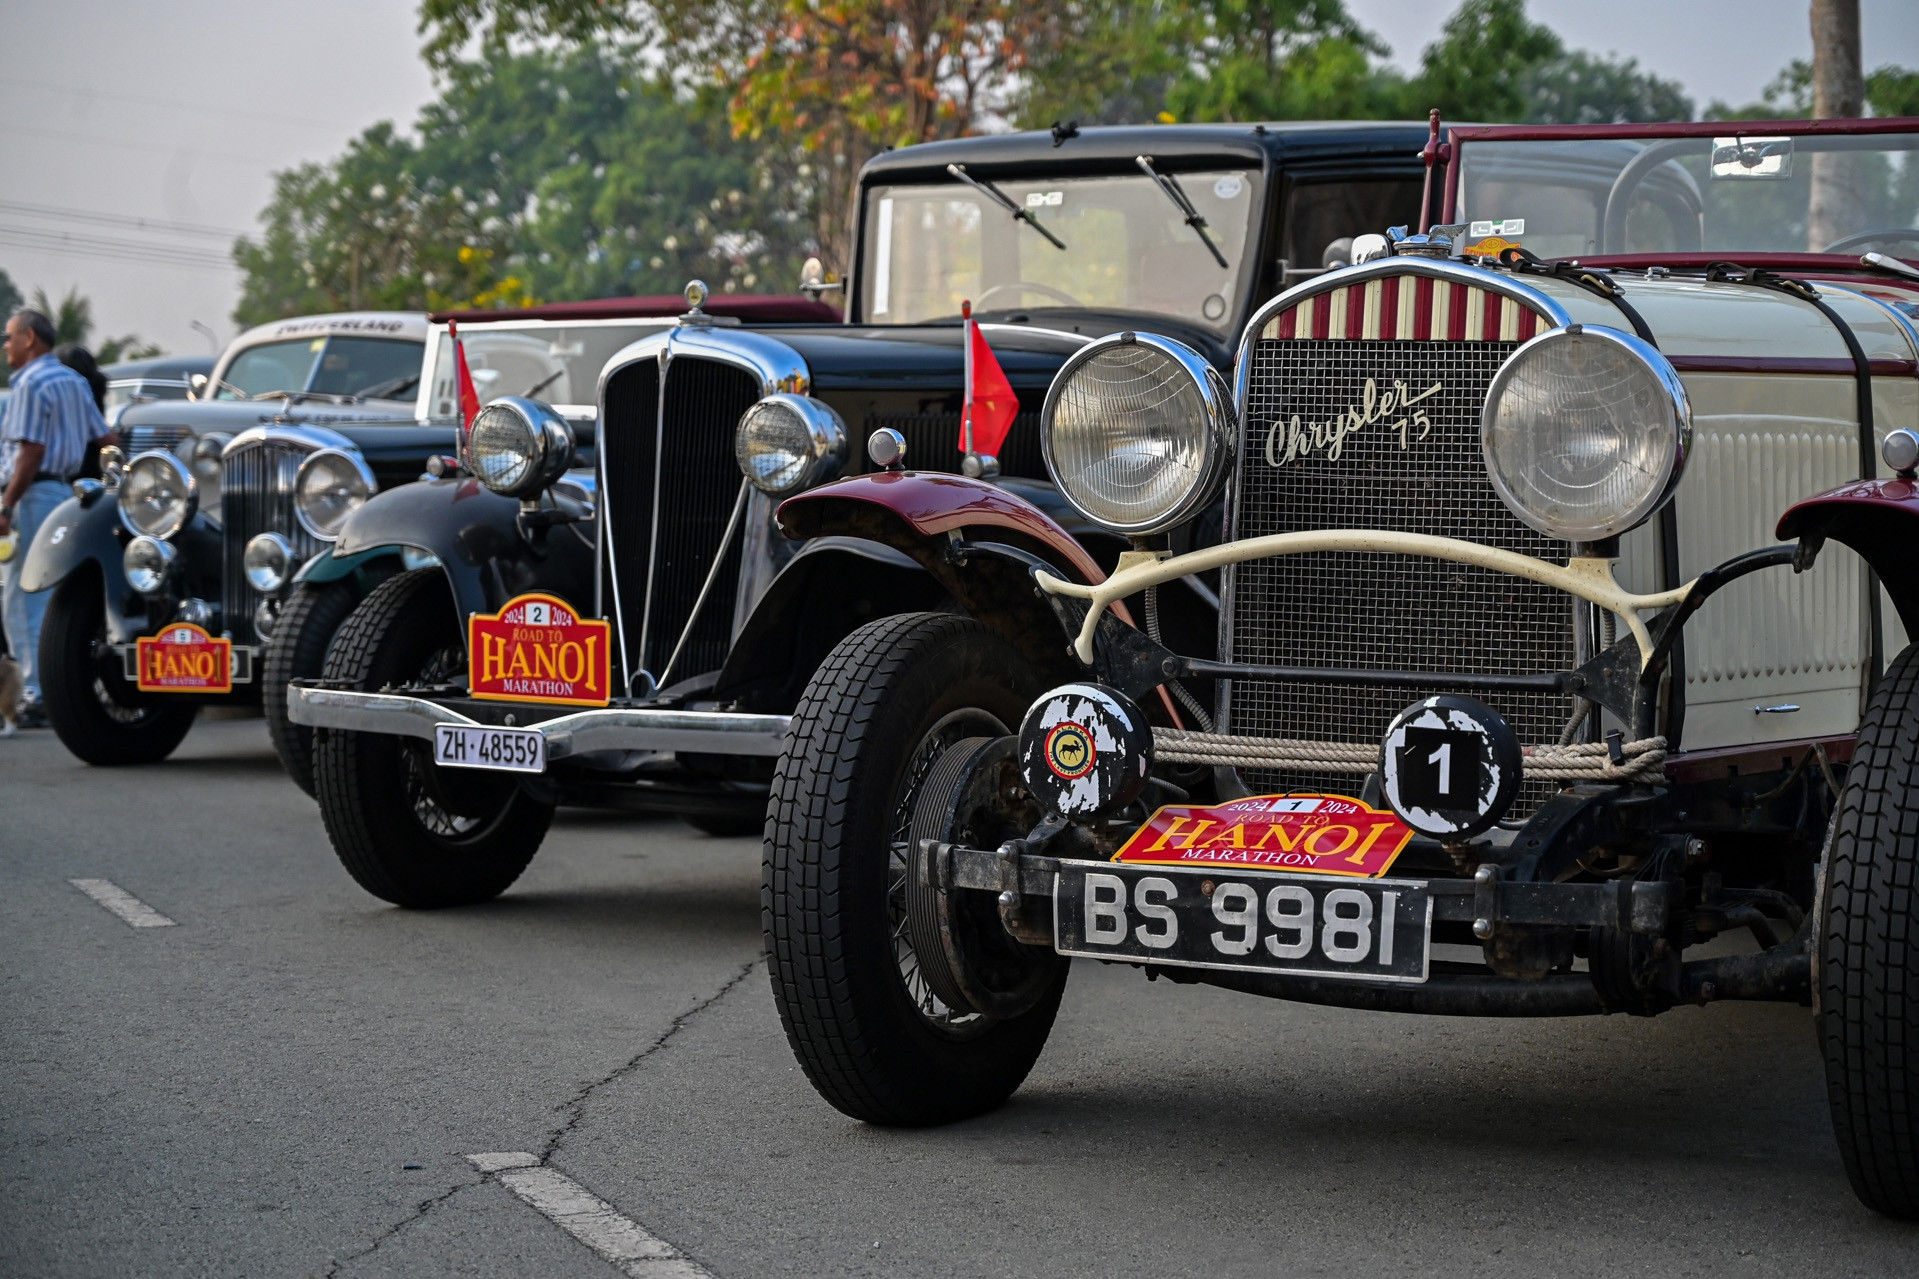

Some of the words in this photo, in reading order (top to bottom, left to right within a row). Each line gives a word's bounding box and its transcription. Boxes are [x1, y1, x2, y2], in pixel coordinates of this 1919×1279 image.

[1265, 377, 1442, 467] Chrysler
[1391, 409, 1431, 450] 75
[504, 606, 525, 625] 2024
[533, 606, 542, 623] 2
[552, 606, 573, 626] 2024
[512, 627, 544, 642] ROAD
[549, 629, 563, 644] TO
[145, 644, 222, 683] HANOI
[481, 631, 597, 692] HANOI
[503, 679, 574, 695] MARATHON
[1056, 725, 1088, 741] ALASKA
[1427, 742, 1452, 795] 1
[1227, 800, 1272, 812] 2024
[1289, 800, 1304, 812] 1
[1318, 800, 1359, 815] 2024
[1234, 813, 1295, 824] ROAD
[1302, 814, 1330, 825] TO
[1142, 816, 1395, 866] HANOI
[1180, 848, 1321, 866] MARATHON
[1084, 872, 1179, 949] BS
[1210, 882, 1398, 966] 9981
